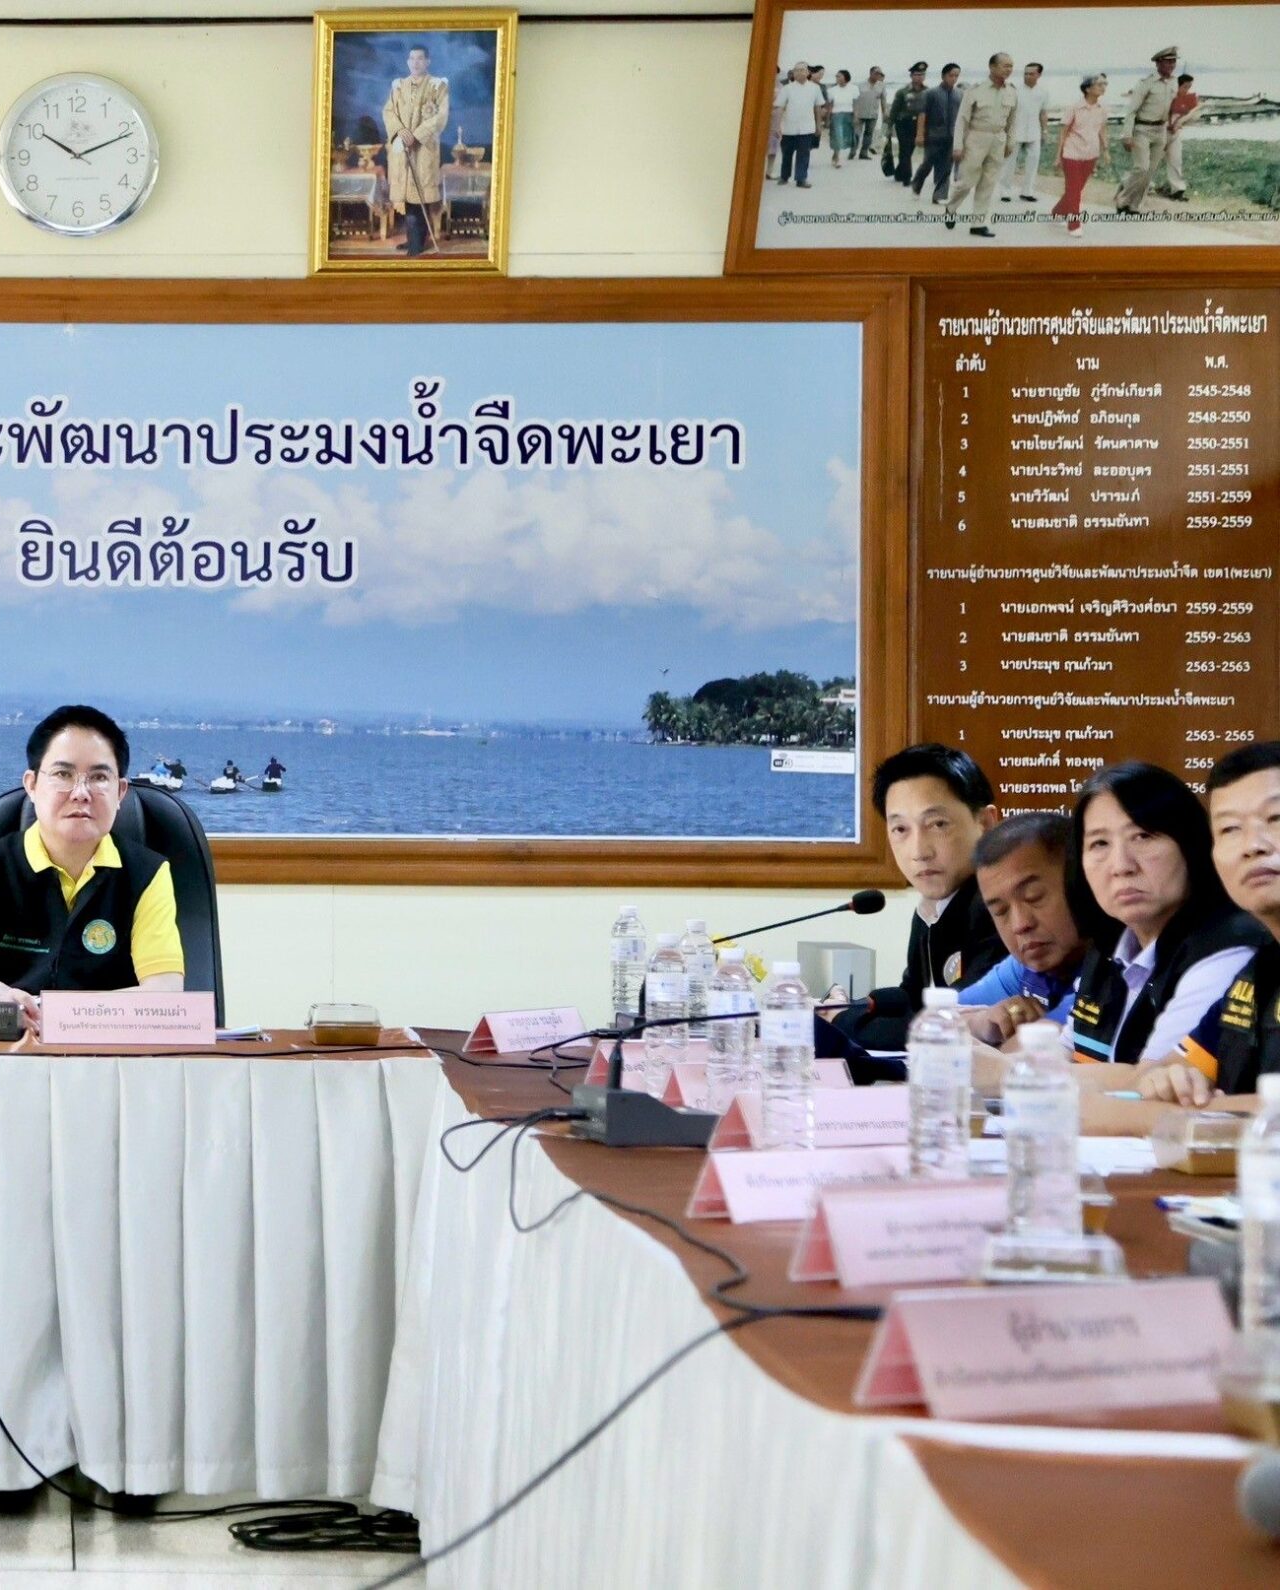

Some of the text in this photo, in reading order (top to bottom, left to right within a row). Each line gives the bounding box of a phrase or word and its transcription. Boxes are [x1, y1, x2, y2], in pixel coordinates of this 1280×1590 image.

[45, 104, 59, 119] 11
[68, 96, 86, 113] 12
[101, 103, 106, 118] 1
[26, 123, 45, 140] 10
[118, 122, 129, 137] 2
[18, 150, 30, 166] 9
[127, 148, 138, 164] 3
[26, 175, 39, 191] 8
[118, 174, 128, 188] 4
[47, 195, 57, 210] 7
[72, 201, 84, 217] 6
[100, 194, 111, 210] 5
[956, 353, 1228, 371] ลำดับ นาม พ.ศ.
[963, 387, 968, 397] 1
[1189, 385, 1251, 396] 2545-2548
[961, 413, 968, 424] 2
[1188, 411, 1250, 423] 2548-2550
[961, 438, 968, 449] 3
[1188, 438, 1248, 449] 2550-2551
[959, 466, 966, 476] 4
[1188, 464, 1248, 476] 2551-2551
[958, 491, 965, 502] 5
[1188, 491, 1251, 503] 2551-2559
[958, 520, 966, 531] 6
[1187, 516, 1252, 528] 2559-2559
[18, 518, 355, 585] ยินดีต้อนรับ
[960, 603, 965, 614] 1
[960, 632, 967, 643] 2
[960, 661, 967, 671] 3
[1186, 661, 1250, 672] 2563-2563
[960, 730, 964, 740] 1
